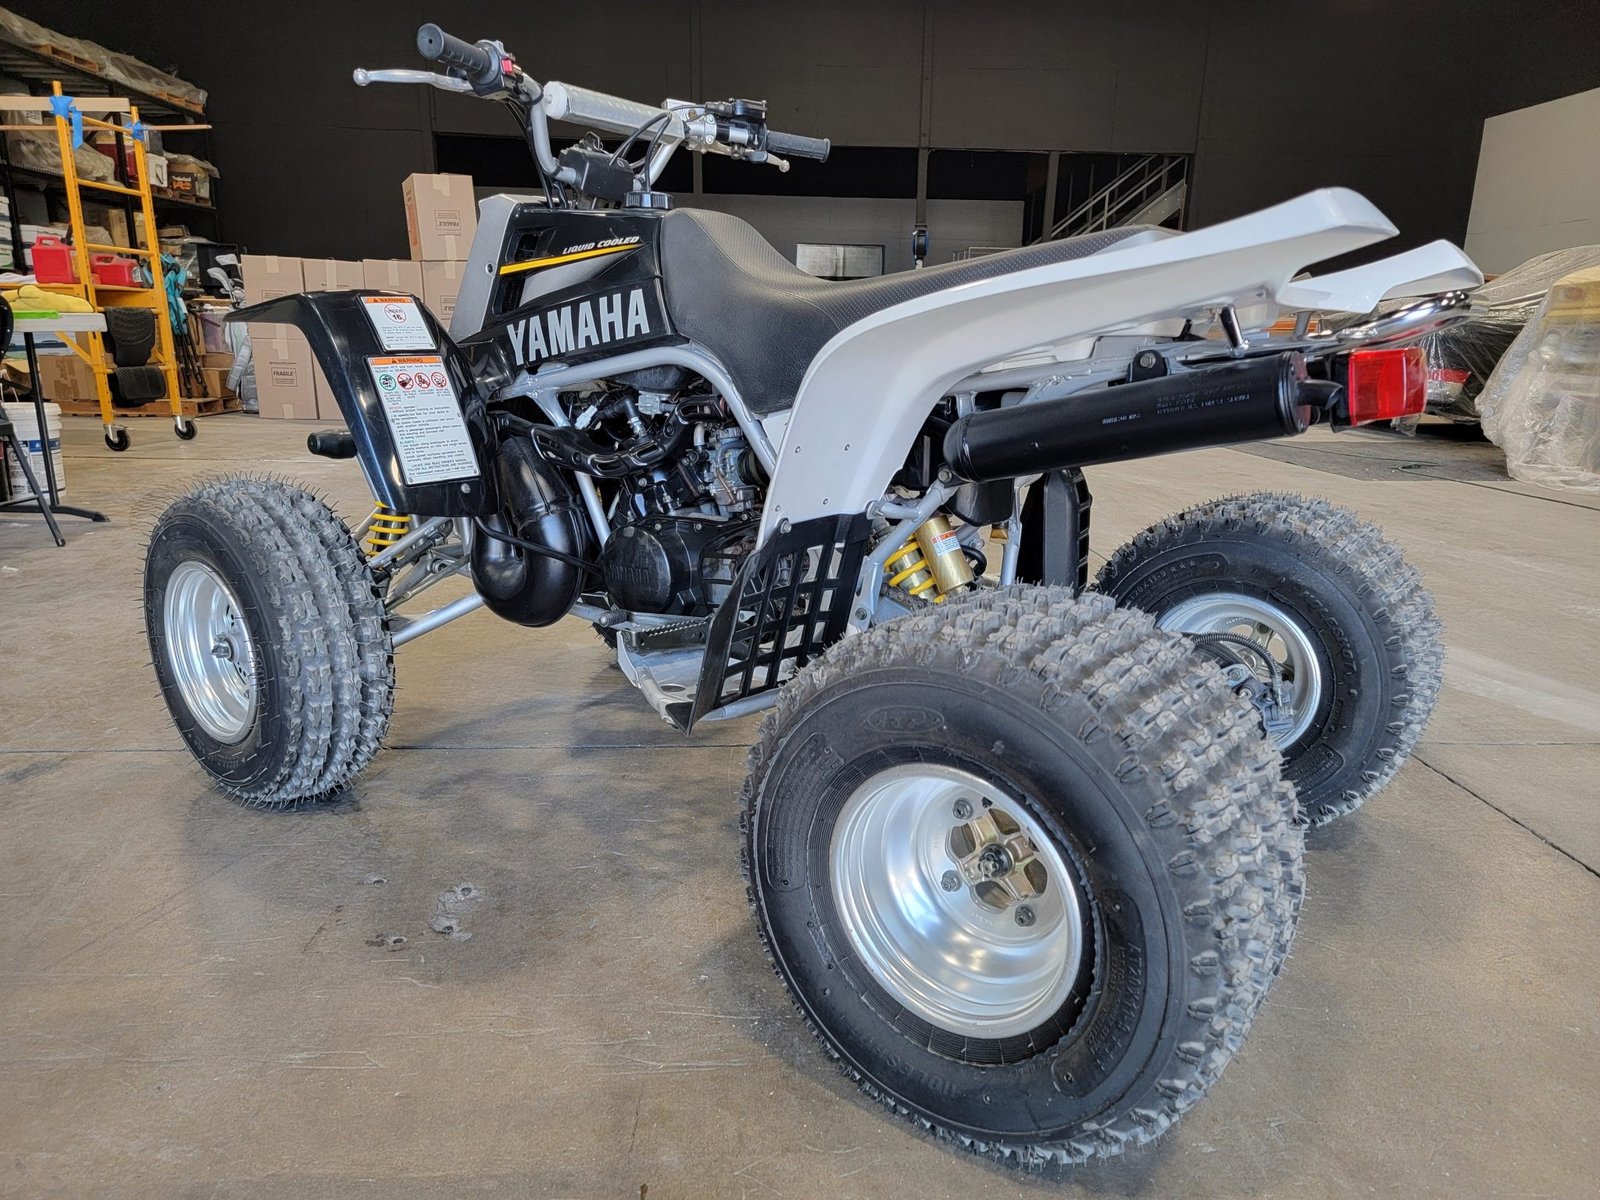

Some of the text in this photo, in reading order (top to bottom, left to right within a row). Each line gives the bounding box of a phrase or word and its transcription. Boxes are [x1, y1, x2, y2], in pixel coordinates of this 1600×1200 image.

[562, 235, 640, 255] LIQUID COOLED
[507, 288, 650, 366] YAMAHA
